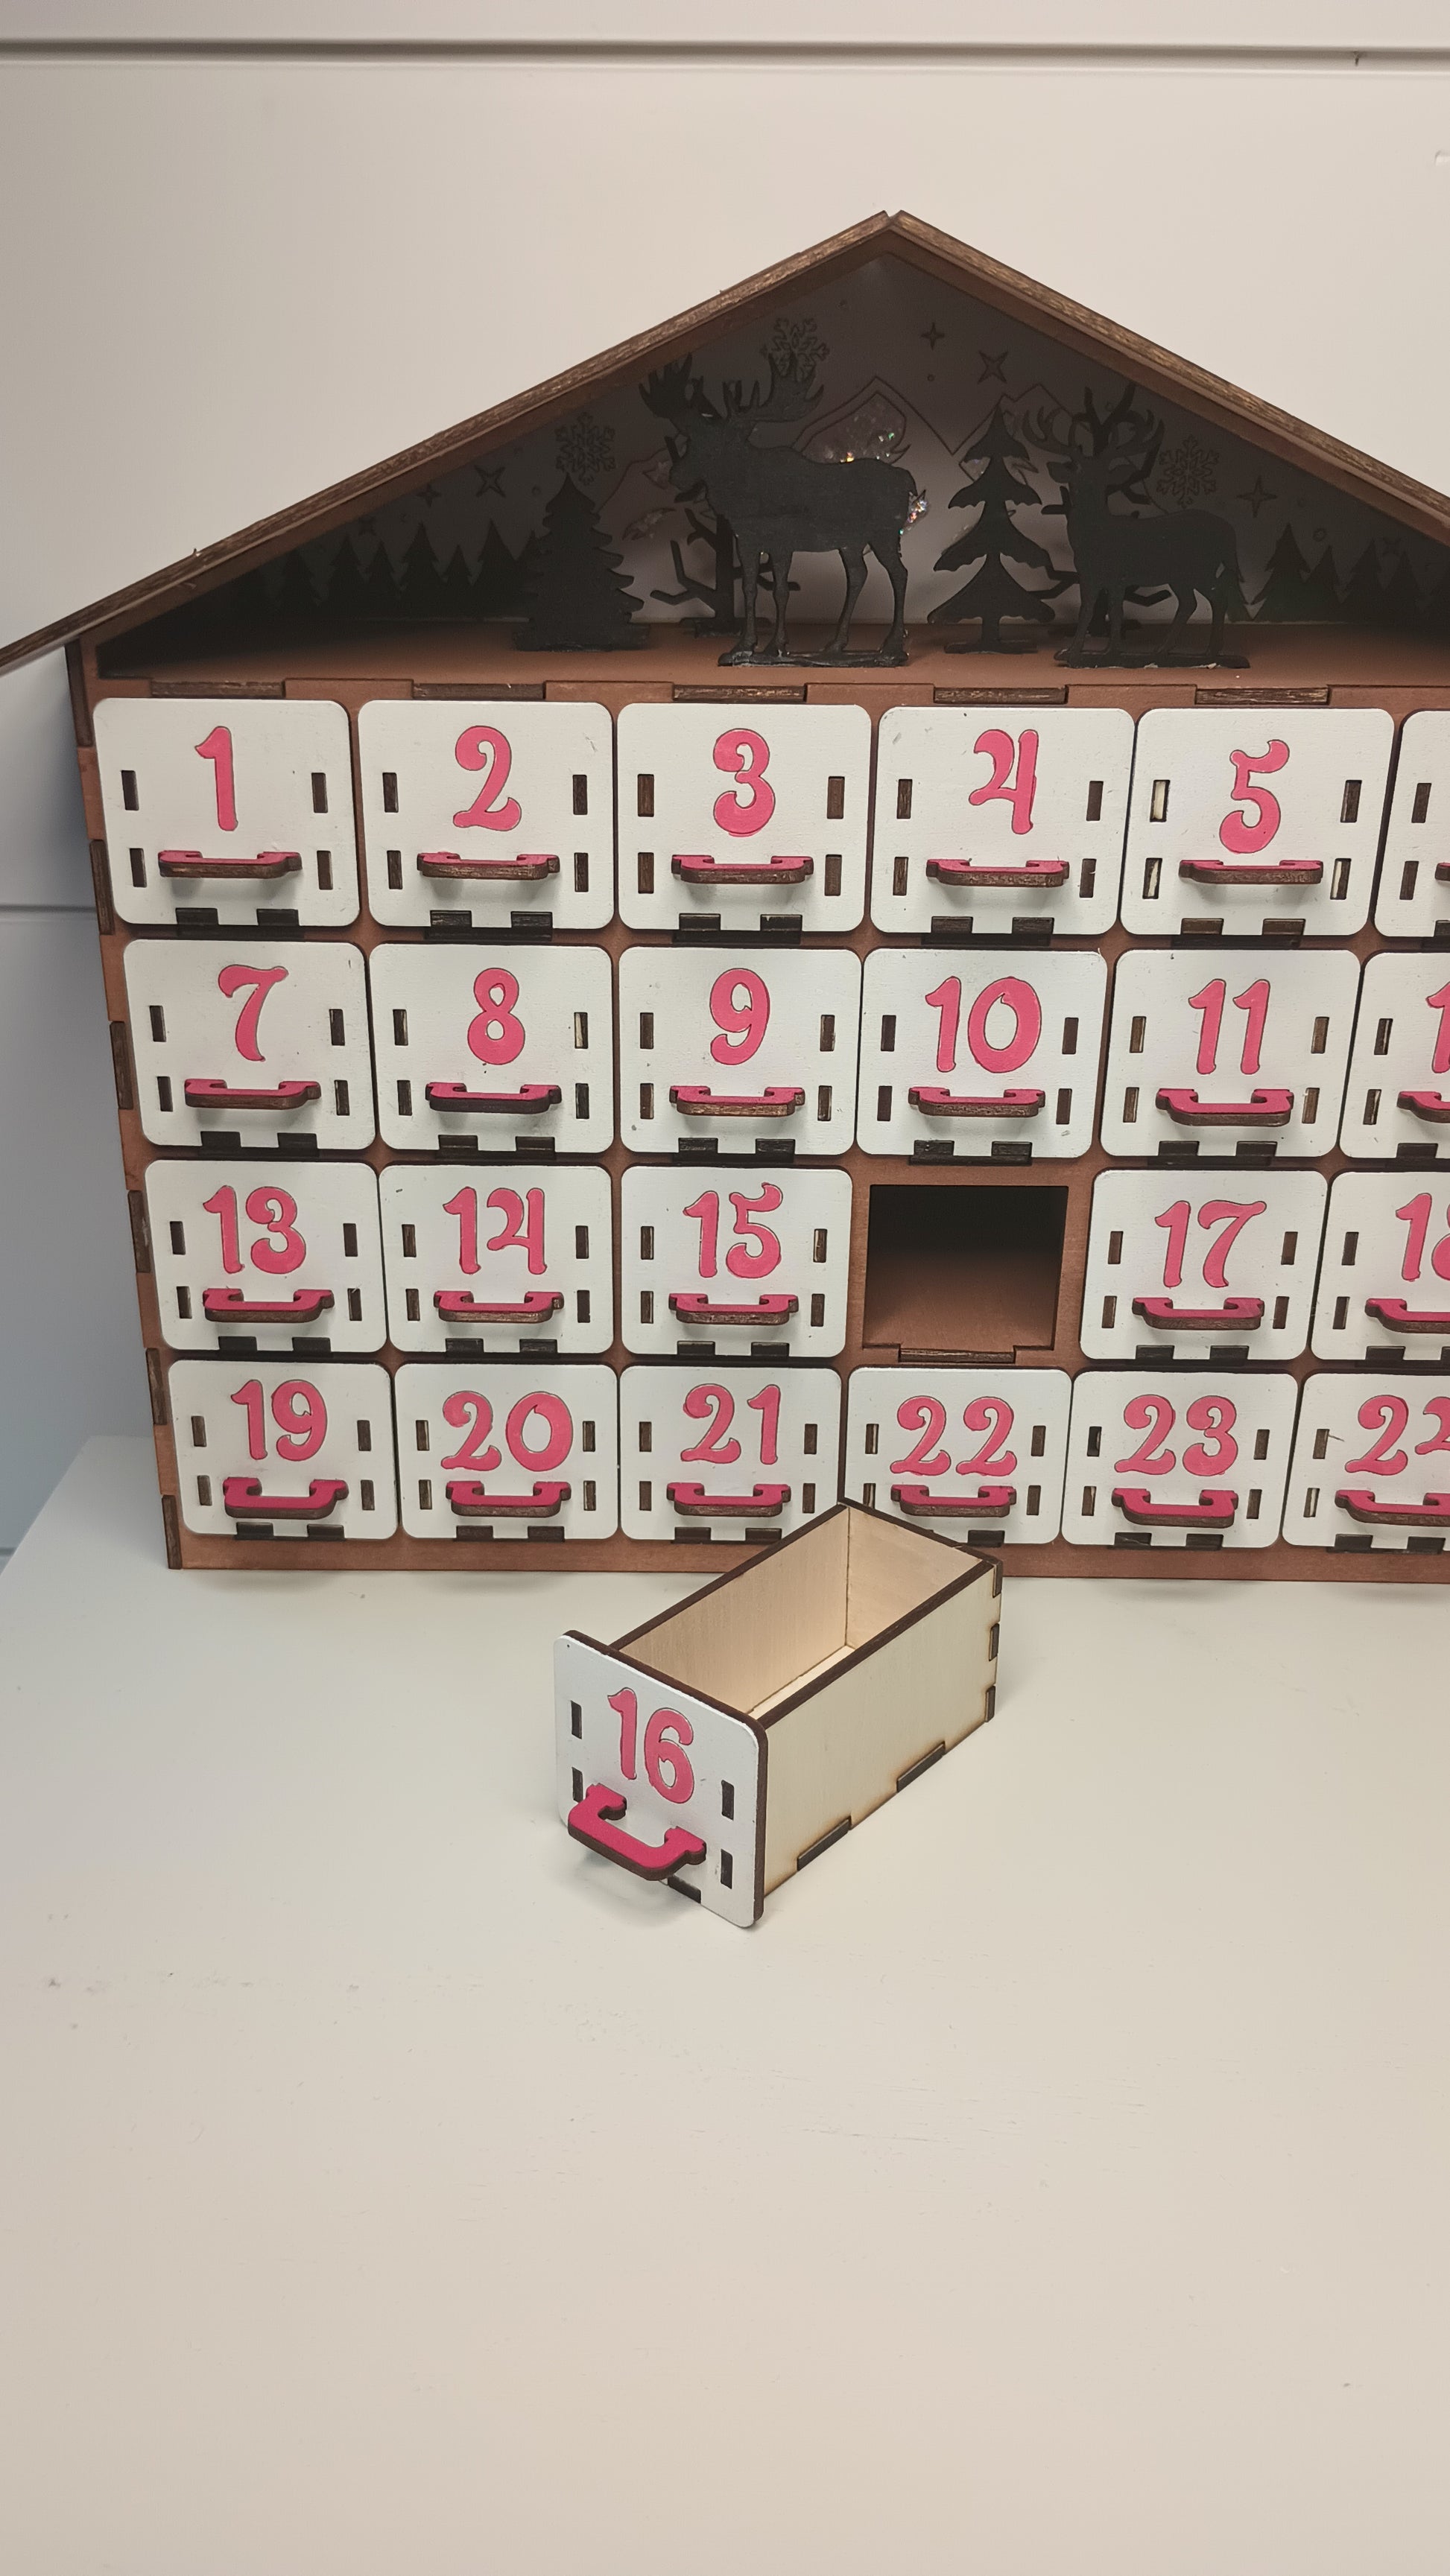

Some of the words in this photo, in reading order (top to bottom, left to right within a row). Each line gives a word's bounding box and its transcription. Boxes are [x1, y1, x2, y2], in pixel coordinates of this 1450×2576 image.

[195, 726, 238, 832] 1
[452, 726, 522, 832] 2
[712, 729, 776, 839] 3
[968, 729, 1039, 835] 4
[1218, 739, 1291, 854] 5
[218, 964, 289, 1062] 7
[466, 967, 525, 1066] 8
[709, 968, 770, 1065] 9
[925, 976, 1042, 1073] 10
[1188, 978, 1270, 1075] 11
[203, 1185, 307, 1275] 13
[443, 1186, 548, 1275] 14
[683, 1182, 782, 1279] 15
[1154, 1199, 1267, 1288] 17
[230, 1379, 328, 1462] 19
[440, 1390, 574, 1472] 20
[680, 1383, 781, 1466] 21
[889, 1395, 1018, 1478] 22
[1113, 1394, 1239, 1477] 23
[607, 1687, 695, 1804] 16
